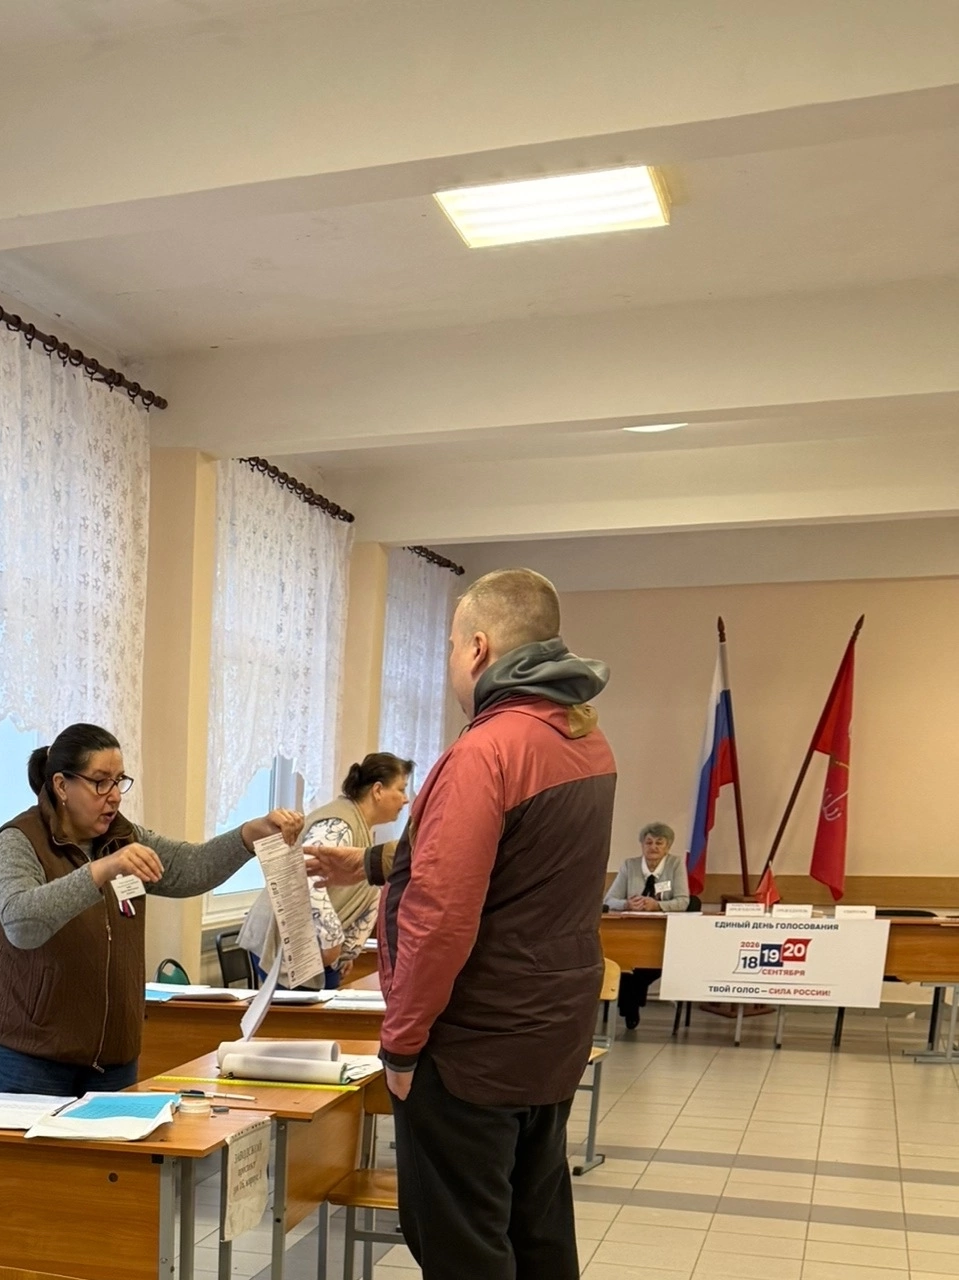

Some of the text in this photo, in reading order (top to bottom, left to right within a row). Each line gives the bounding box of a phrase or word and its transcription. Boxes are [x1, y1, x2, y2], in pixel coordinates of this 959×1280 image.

[715, 920, 839, 930] ЕДИНЫЙ ДЕНЬ ГОЛОСОВАНИЯ
[741, 943, 805, 969] 18 19 20
[761, 968, 805, 976] СЕНТЯБРЯ
[708, 984, 731, 993] ТВОЙ
[732, 986, 760, 994] ГОЛОС
[768, 987, 791, 995] СИЛА
[793, 989, 831, 997] РОССИИ!
